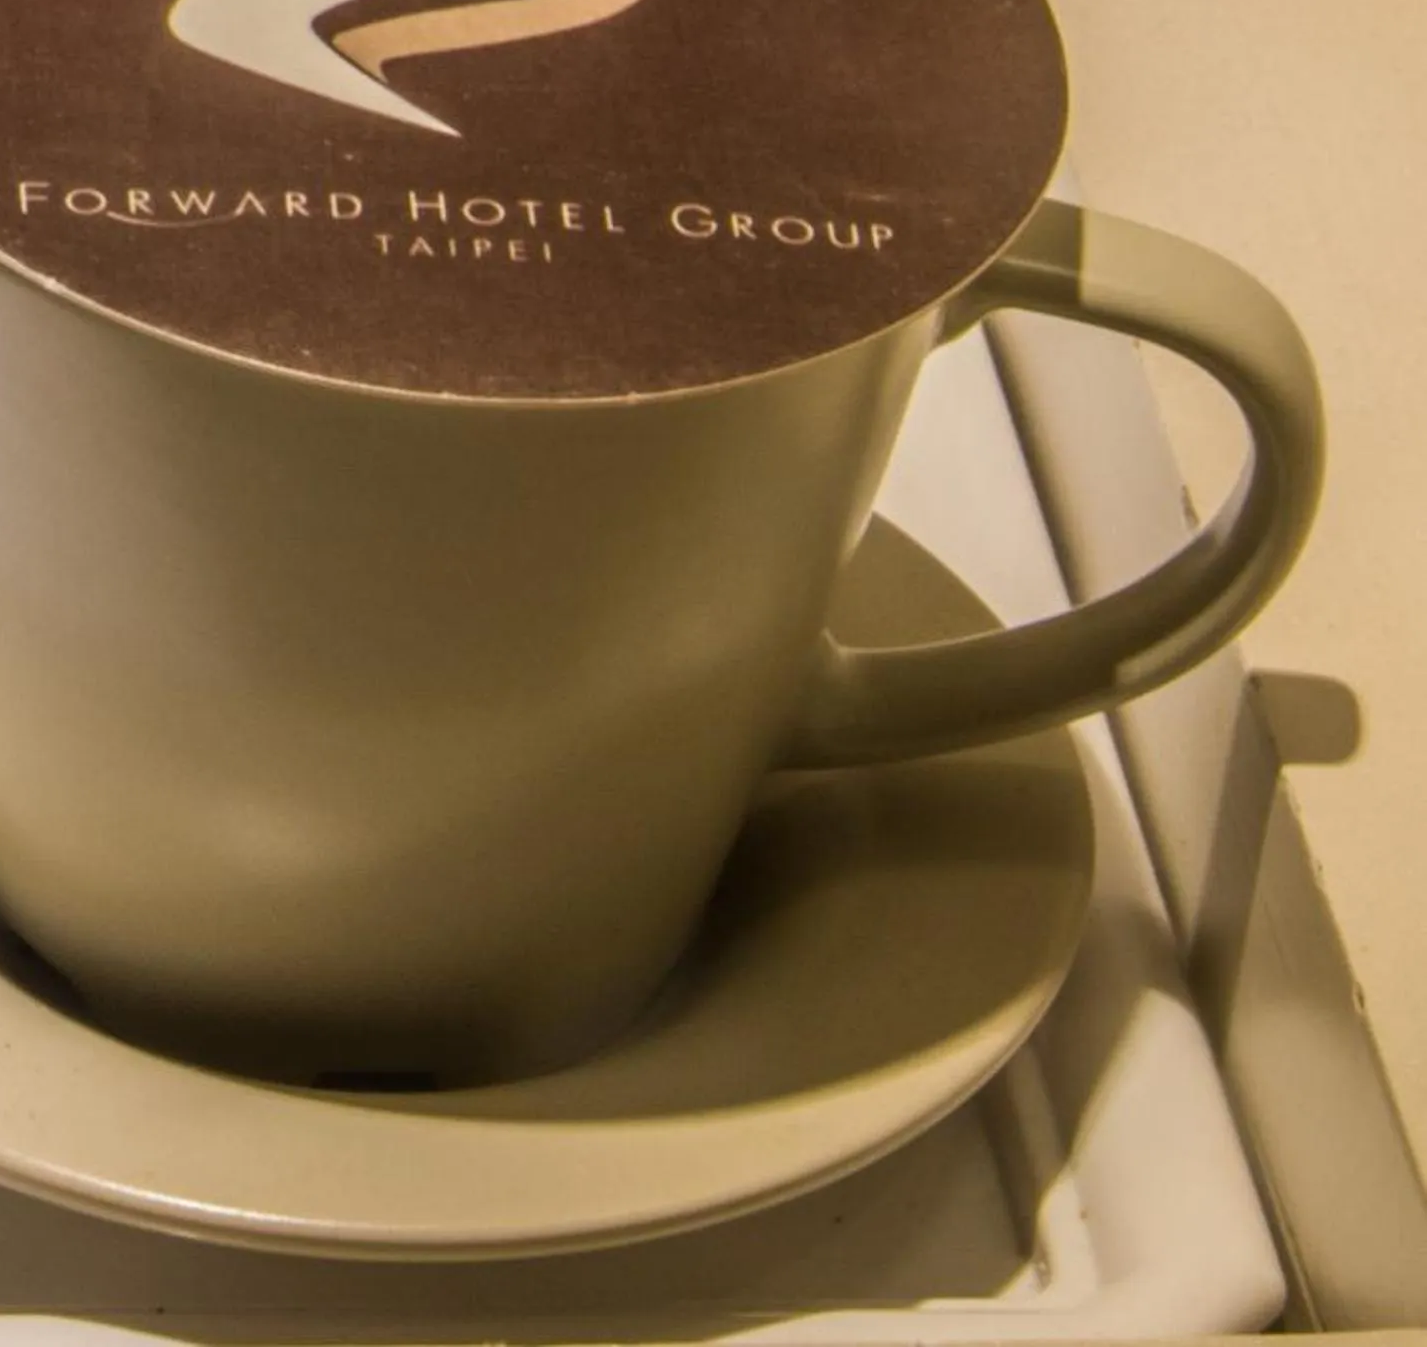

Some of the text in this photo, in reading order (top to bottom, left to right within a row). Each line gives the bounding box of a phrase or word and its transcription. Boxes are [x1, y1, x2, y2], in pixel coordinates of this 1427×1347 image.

[18, 180, 896, 251] FORWARD HOTEL GROUP
[375, 233, 554, 264] TAIPEI
